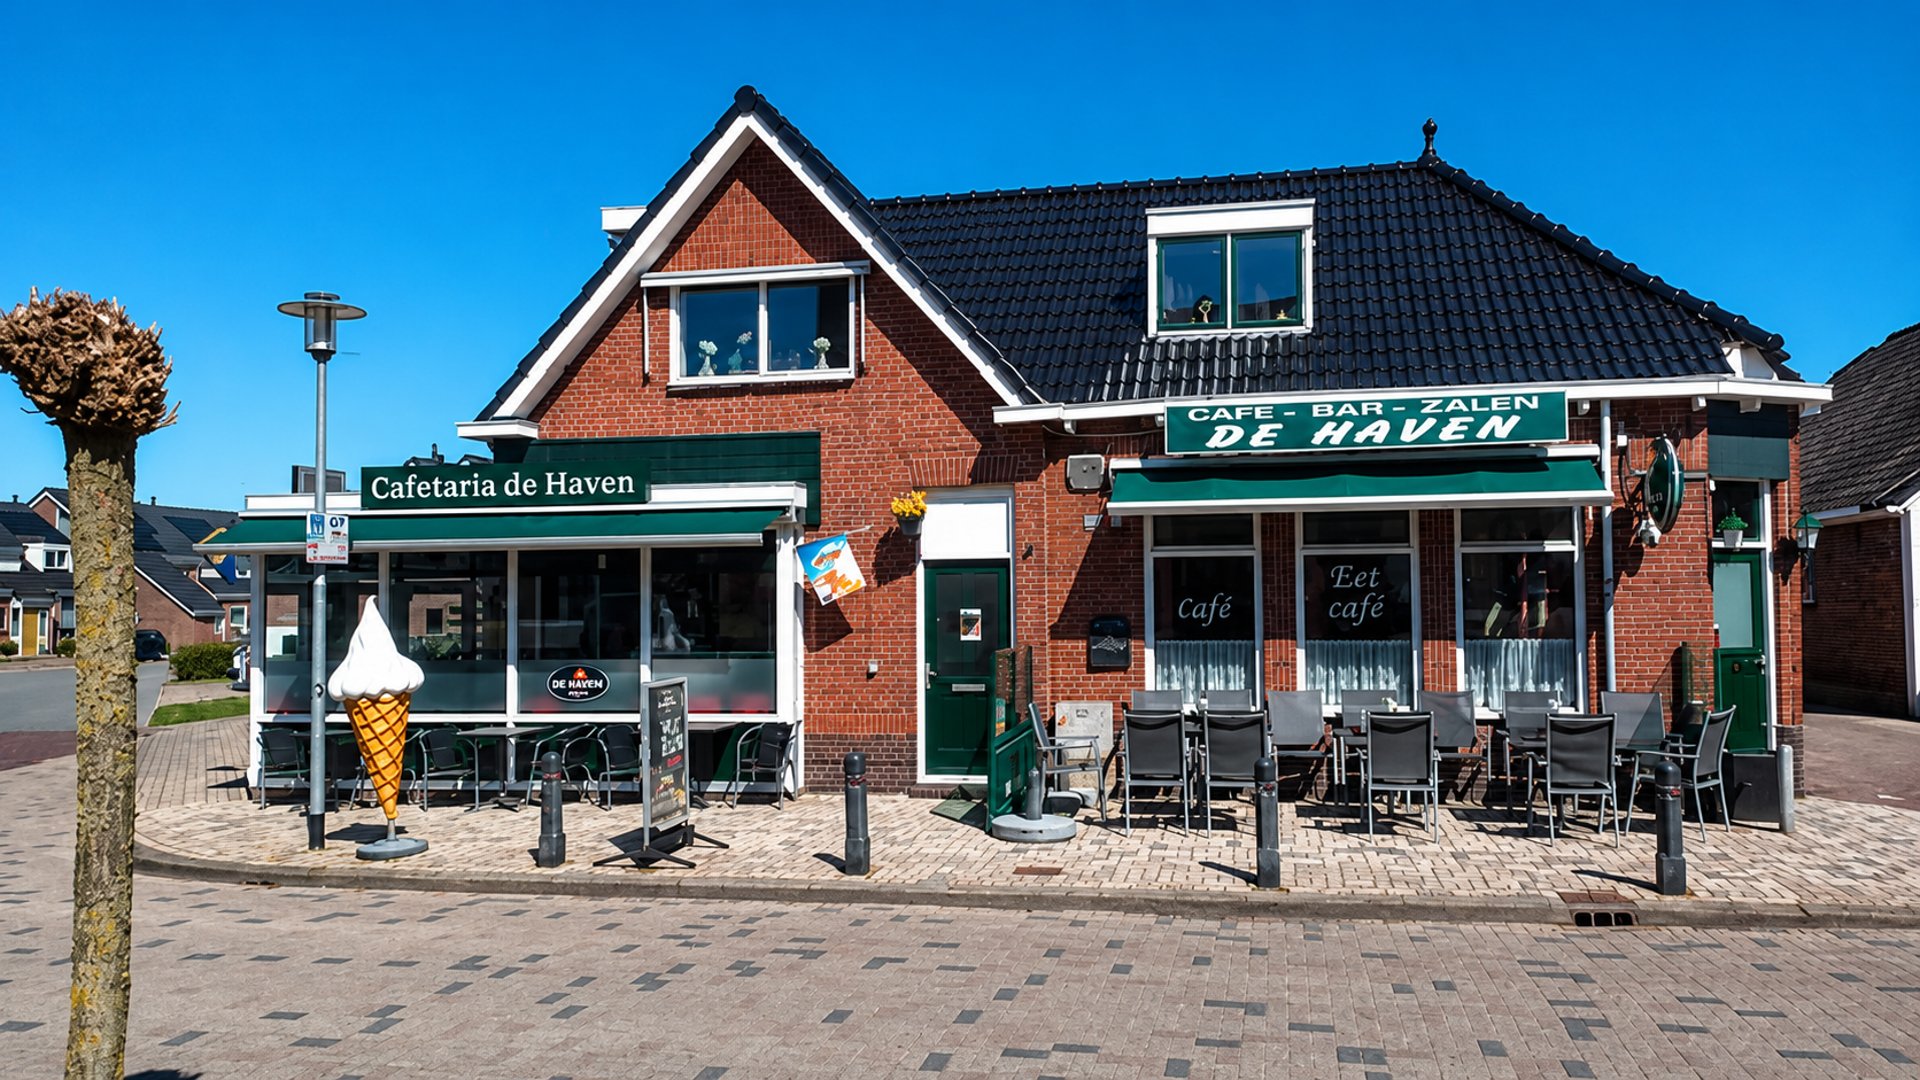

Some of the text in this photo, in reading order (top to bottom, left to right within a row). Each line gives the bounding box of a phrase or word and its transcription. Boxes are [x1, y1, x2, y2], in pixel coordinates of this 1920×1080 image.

[1187, 406, 1274, 422] CAFE
[1312, 402, 1384, 418] BAR
[1420, 395, 1539, 414] ZALEN
[1205, 414, 1521, 449] DE HAVEN
[371, 471, 635, 500] Cafetaria de Haven
[1330, 565, 1380, 588] Eet
[1178, 592, 1233, 627] Café
[1329, 592, 1385, 626] café
[552, 679, 567, 689] DE
